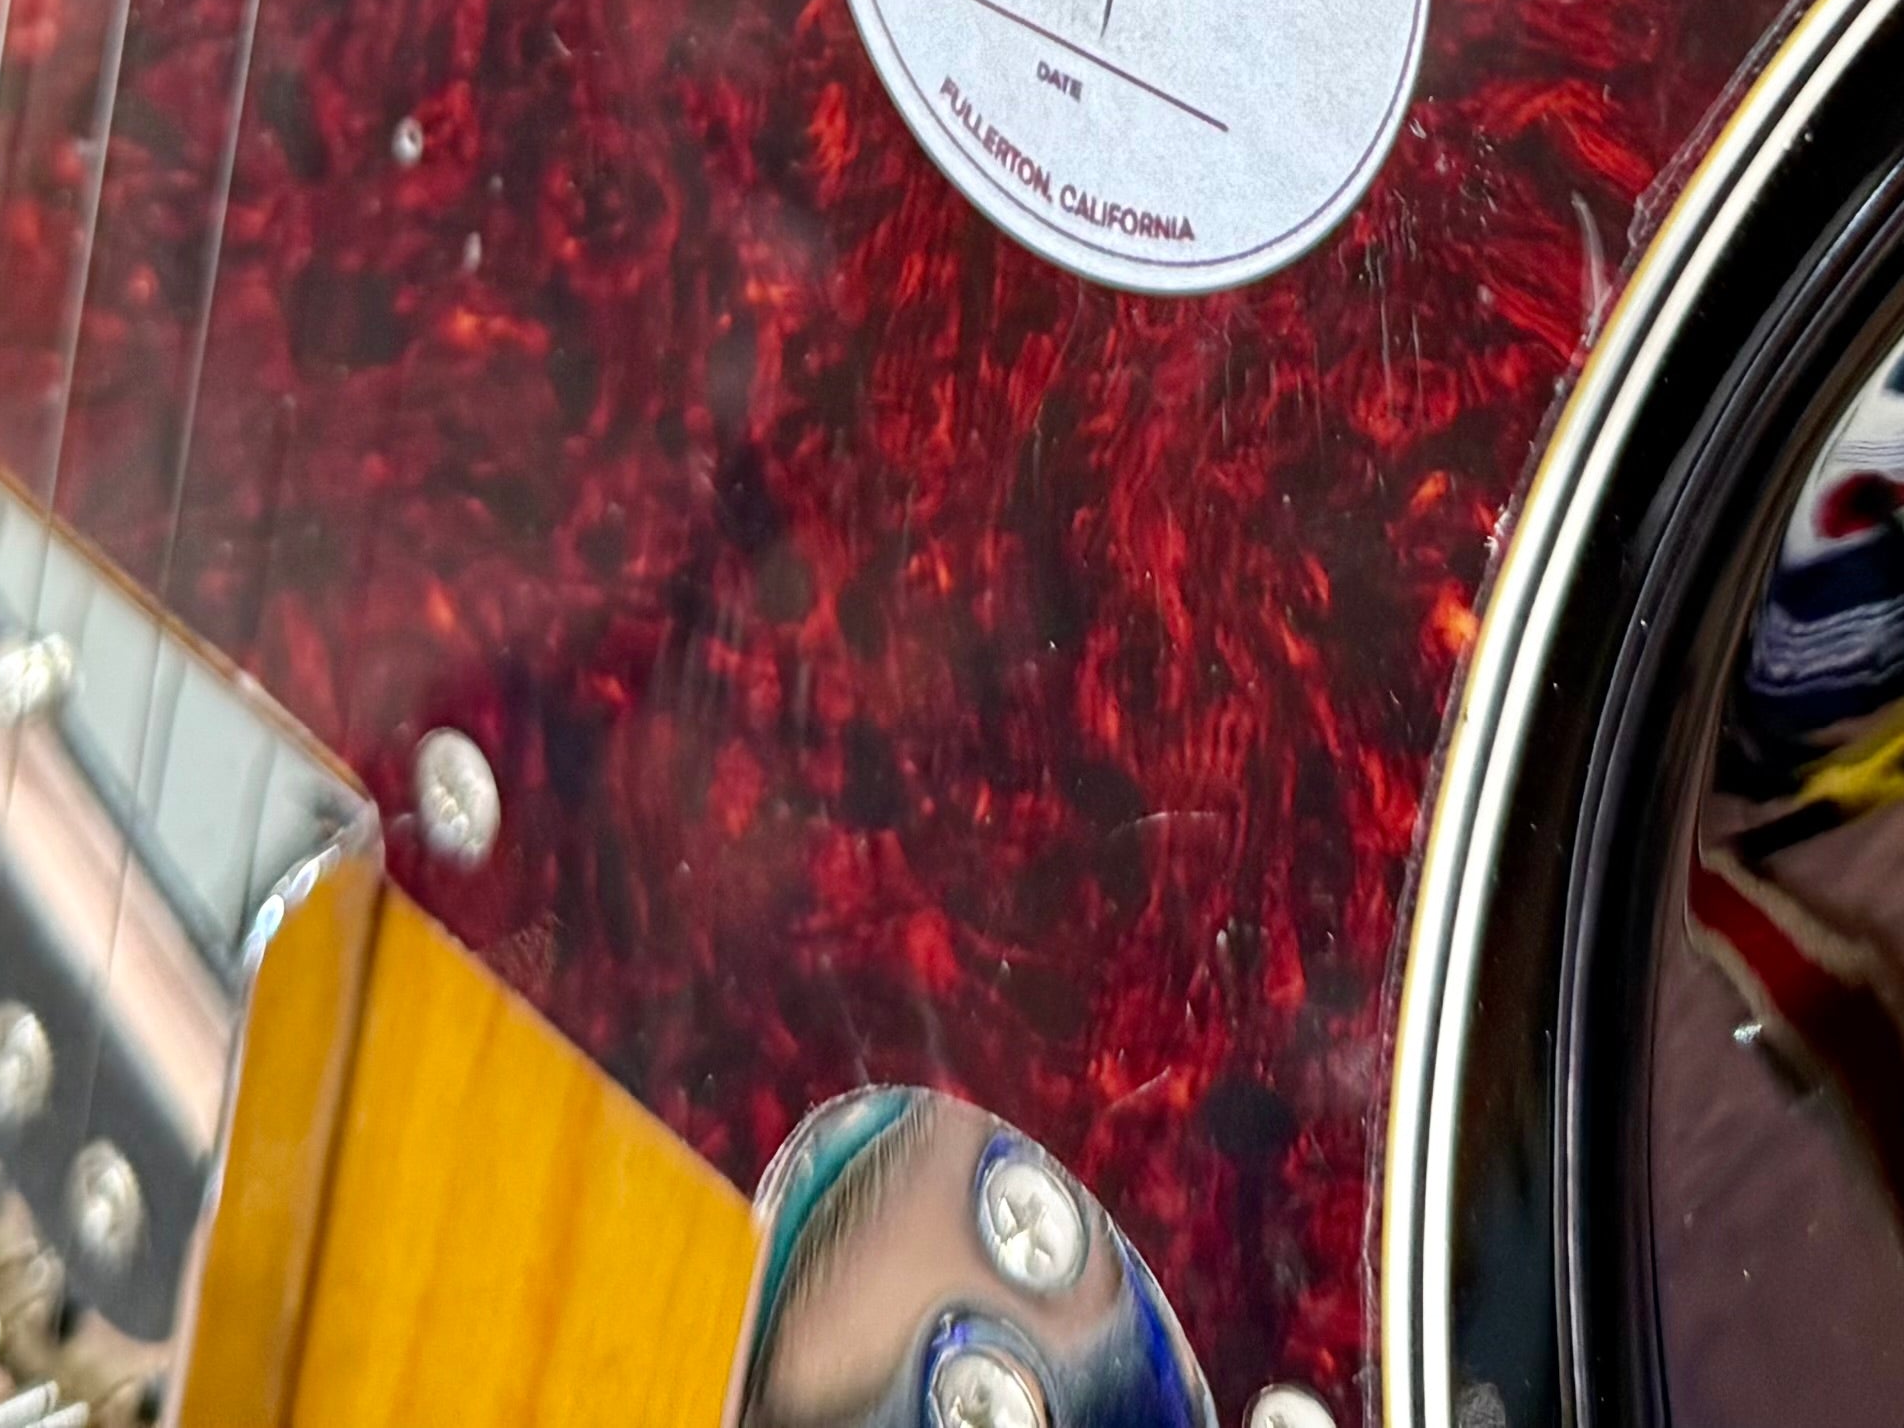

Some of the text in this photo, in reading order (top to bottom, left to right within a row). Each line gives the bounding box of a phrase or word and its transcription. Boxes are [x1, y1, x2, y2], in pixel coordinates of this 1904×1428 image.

[1036, 60, 1084, 104] DATE
[939, 75, 1196, 243] FULLERTON, CALIFORNIA
